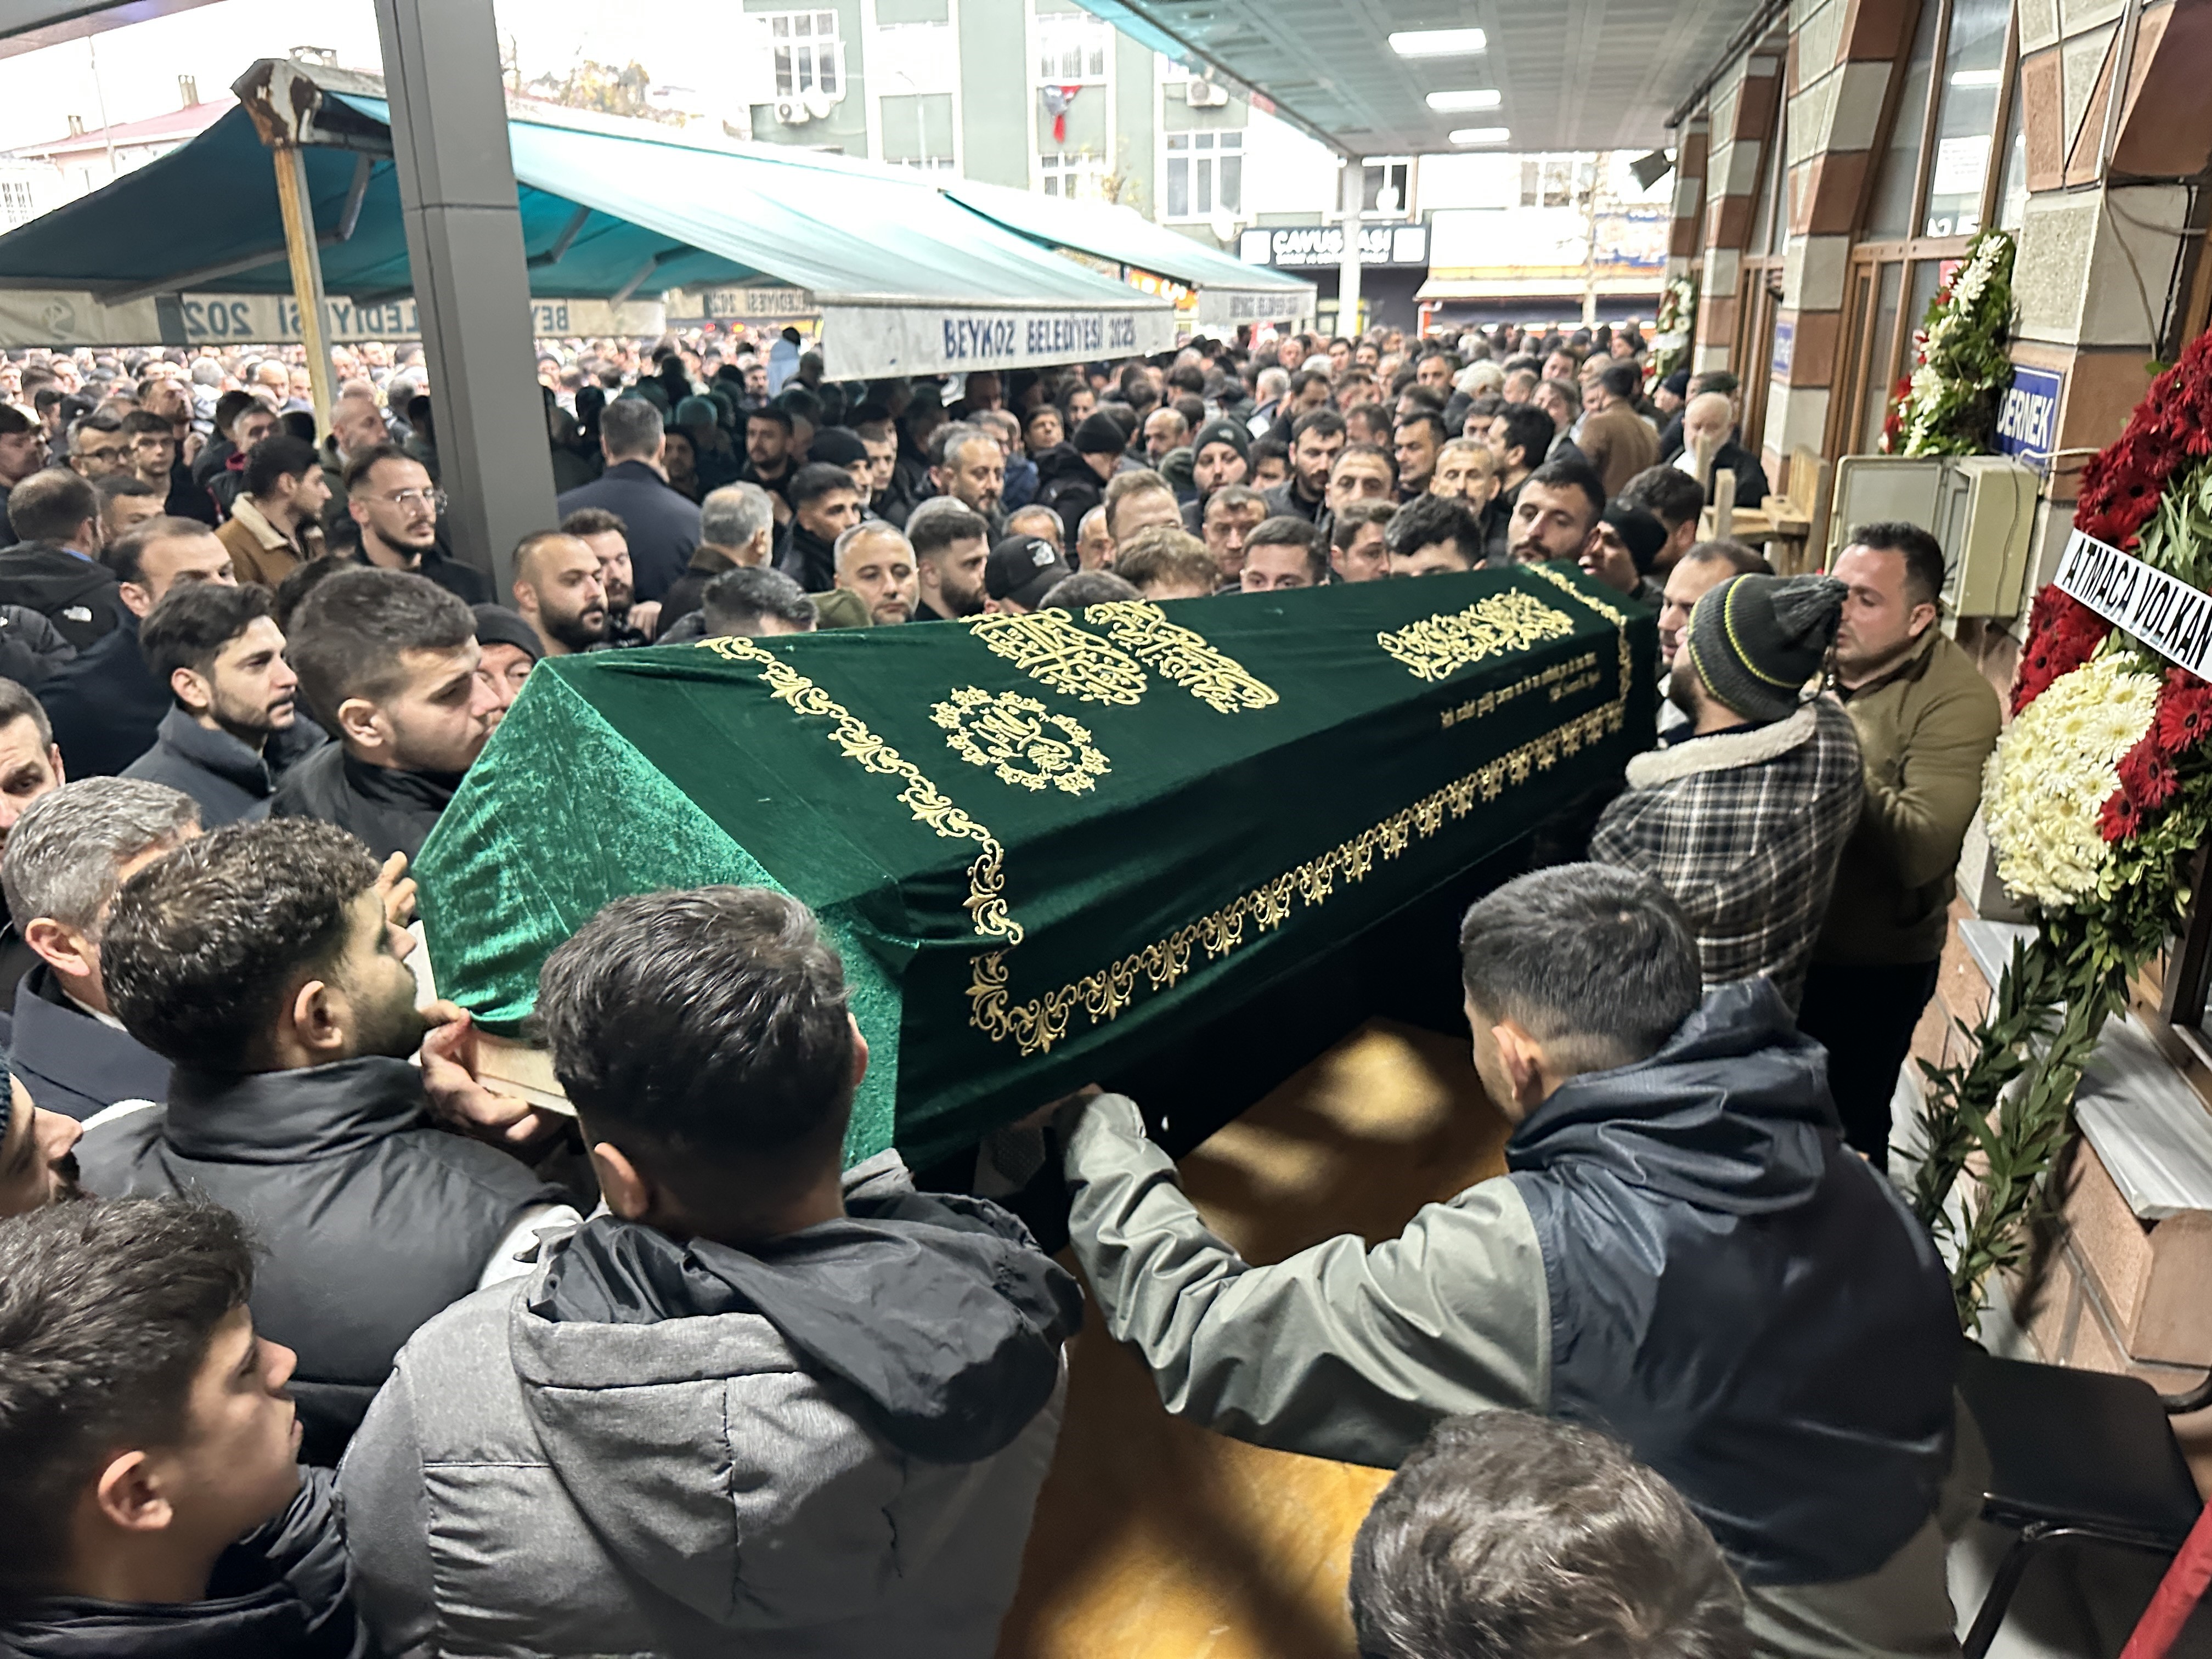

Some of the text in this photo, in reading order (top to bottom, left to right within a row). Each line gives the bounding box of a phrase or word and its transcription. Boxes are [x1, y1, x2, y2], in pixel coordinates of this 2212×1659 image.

[944, 318, 1015, 359] BEYKOZ
[1996, 388, 2053, 449] DERNEK
[2062, 538, 2212, 670] ATMACA VOLKAN
